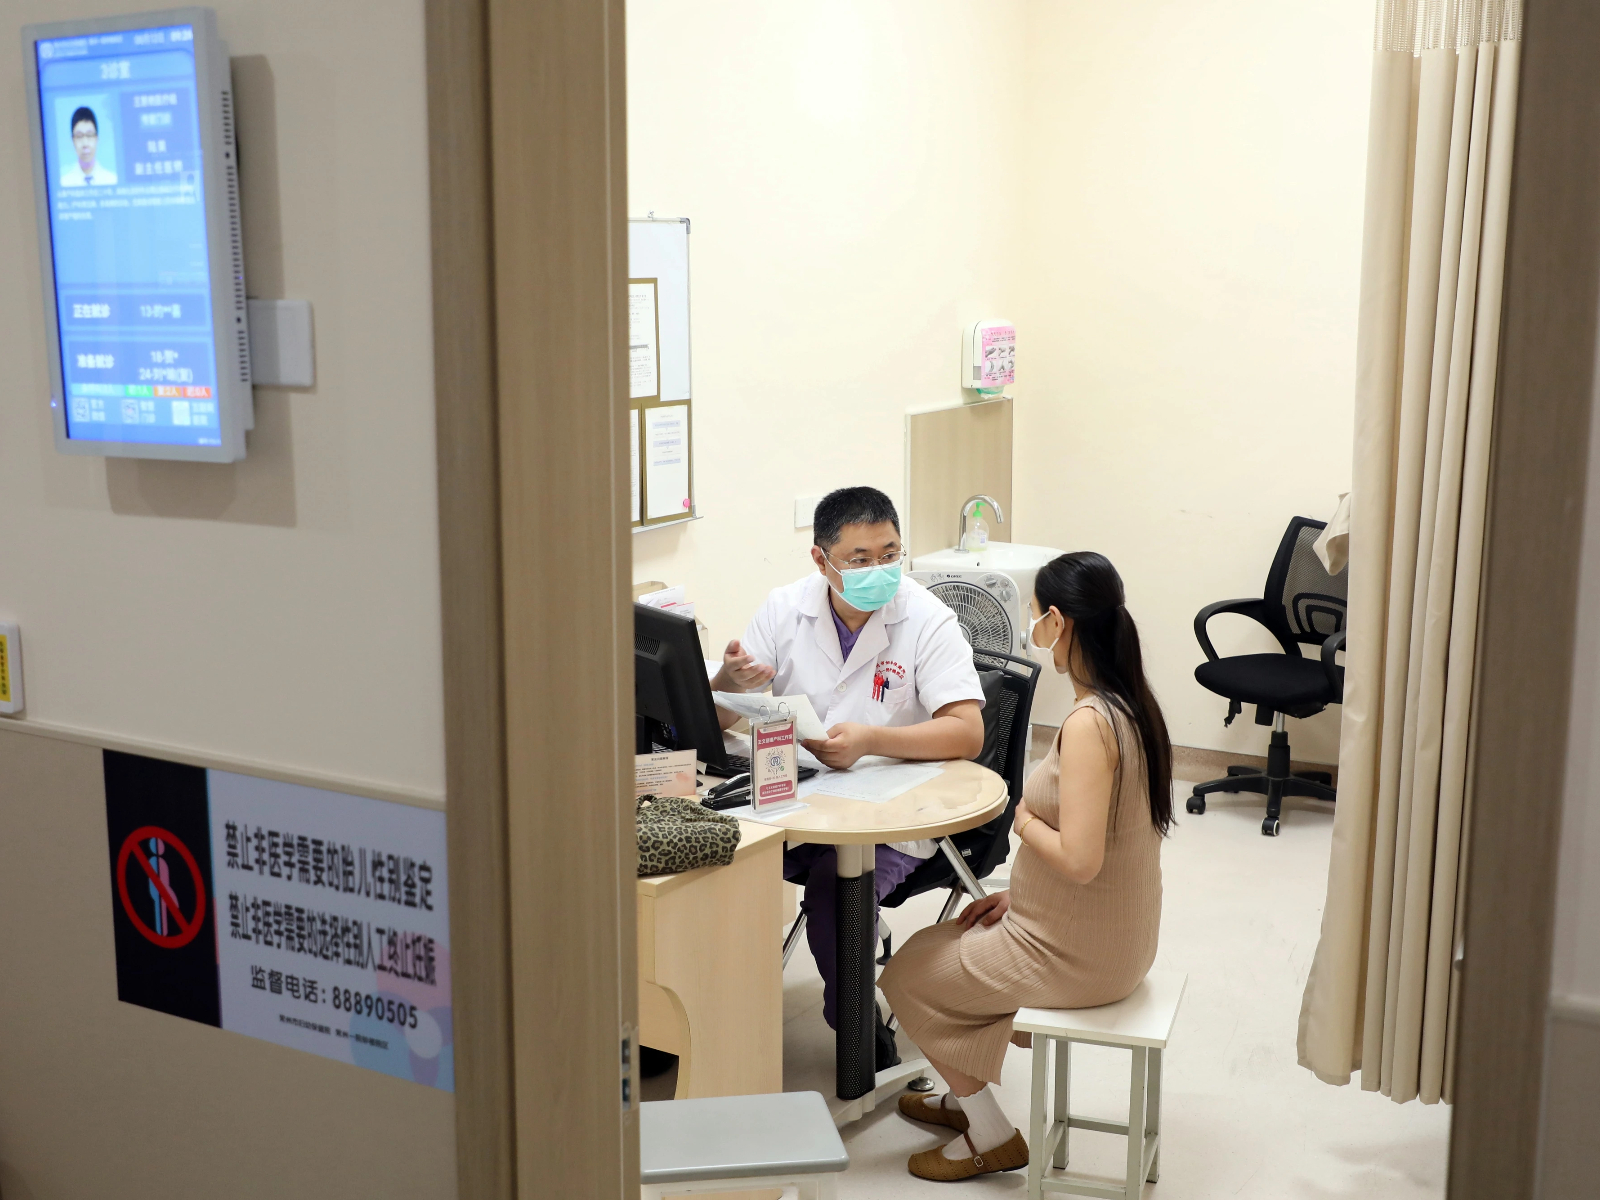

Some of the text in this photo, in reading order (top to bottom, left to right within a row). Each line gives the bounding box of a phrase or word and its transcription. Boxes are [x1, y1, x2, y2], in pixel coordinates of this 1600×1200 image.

[73, 303, 111, 319] 正在就诊
[225, 820, 433, 912] 禁止非医学需要的胎儿性别鉴定
[229, 891, 437, 986] 禁止非医学需要的选择性别人工终止妊娠
